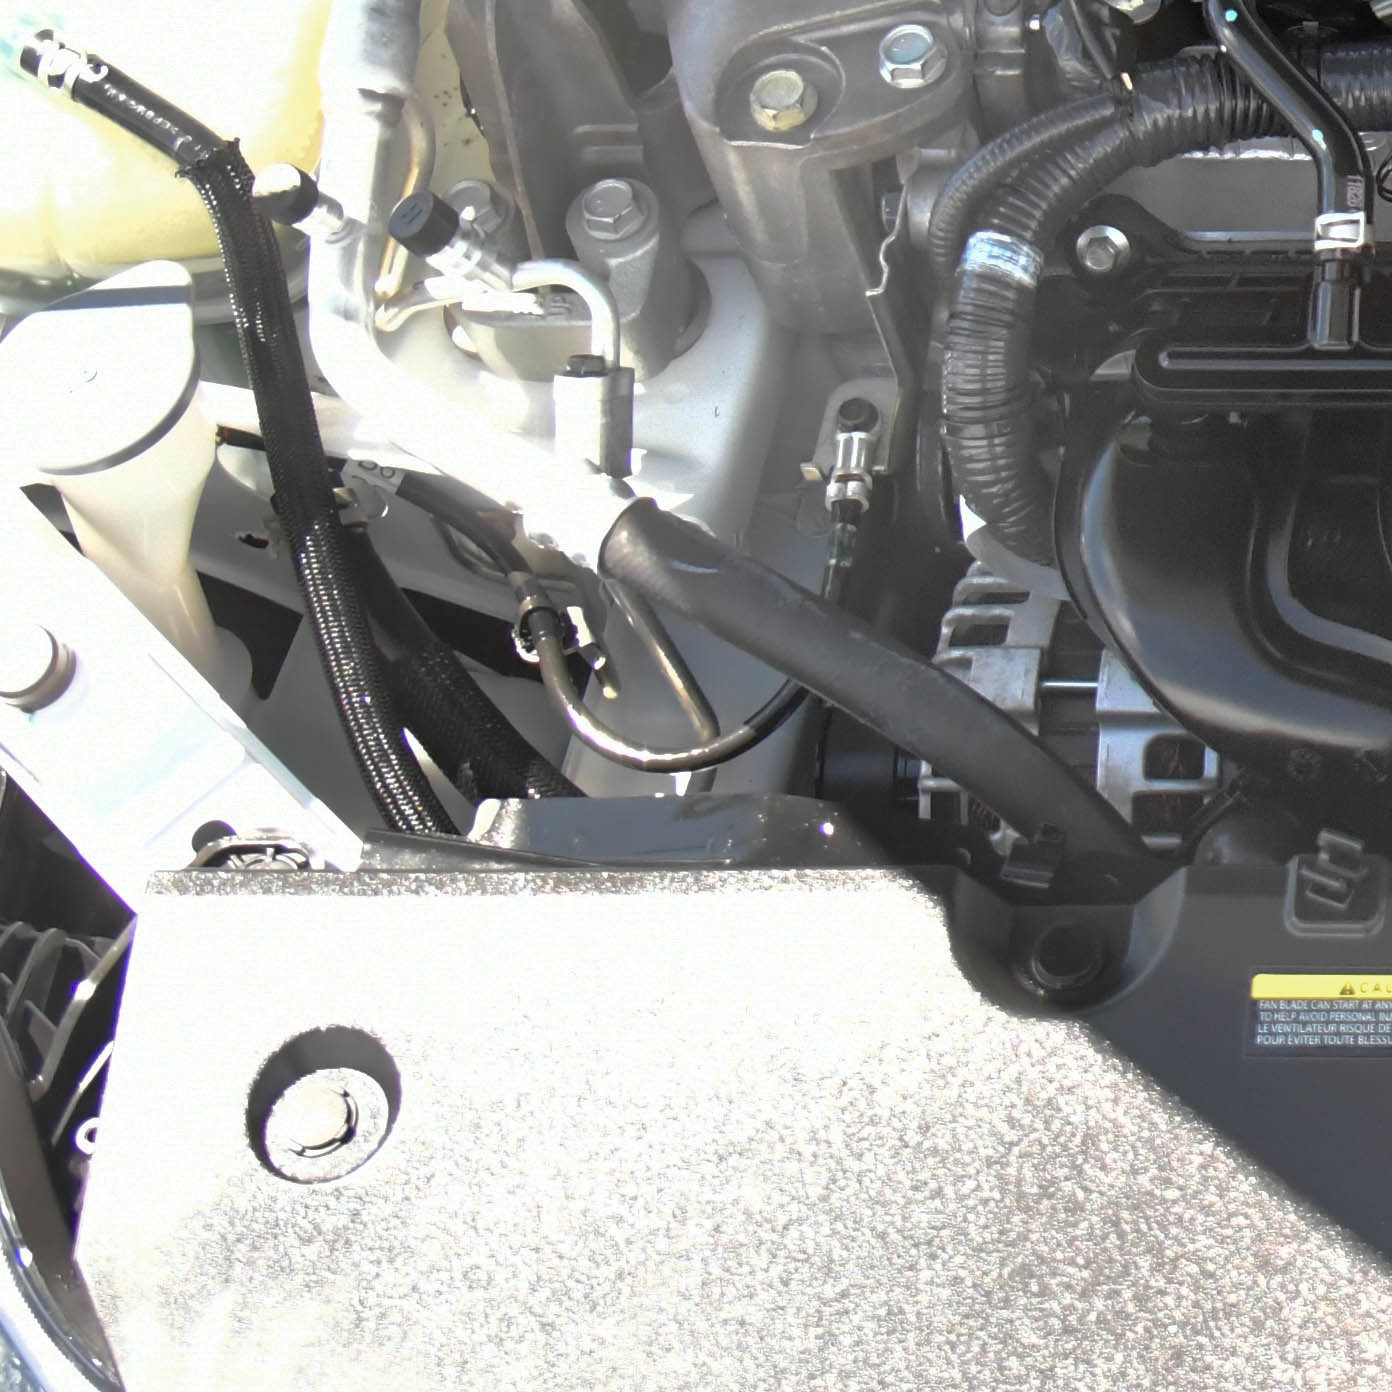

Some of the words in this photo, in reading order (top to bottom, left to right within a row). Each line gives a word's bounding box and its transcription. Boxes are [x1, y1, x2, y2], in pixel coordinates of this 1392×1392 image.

[1259, 1000, 1277, 1009] FAN
[1280, 1000, 1308, 1009] BLADE
[1312, 1000, 1330, 1009] CAN
[1333, 1000, 1359, 1009] START
[1362, 1000, 1372, 1009] AT
[1260, 1012, 1272, 1020] TO
[1274, 1012, 1296, 1020] HELP
[1300, 1012, 1327, 1020] AVOID
[1330, 1012, 1375, 1020] PERSONAL
[1257, 1024, 1268, 1032] LE
[1271, 1024, 1336, 1032] VENTILATEUR
[1340, 1024, 1375, 1033] RISQUE
[1379, 1024, 1391, 1032] DE
[1257, 1036, 1285, 1044] POUR
[1323, 1036, 1355, 1044] TOUTE
